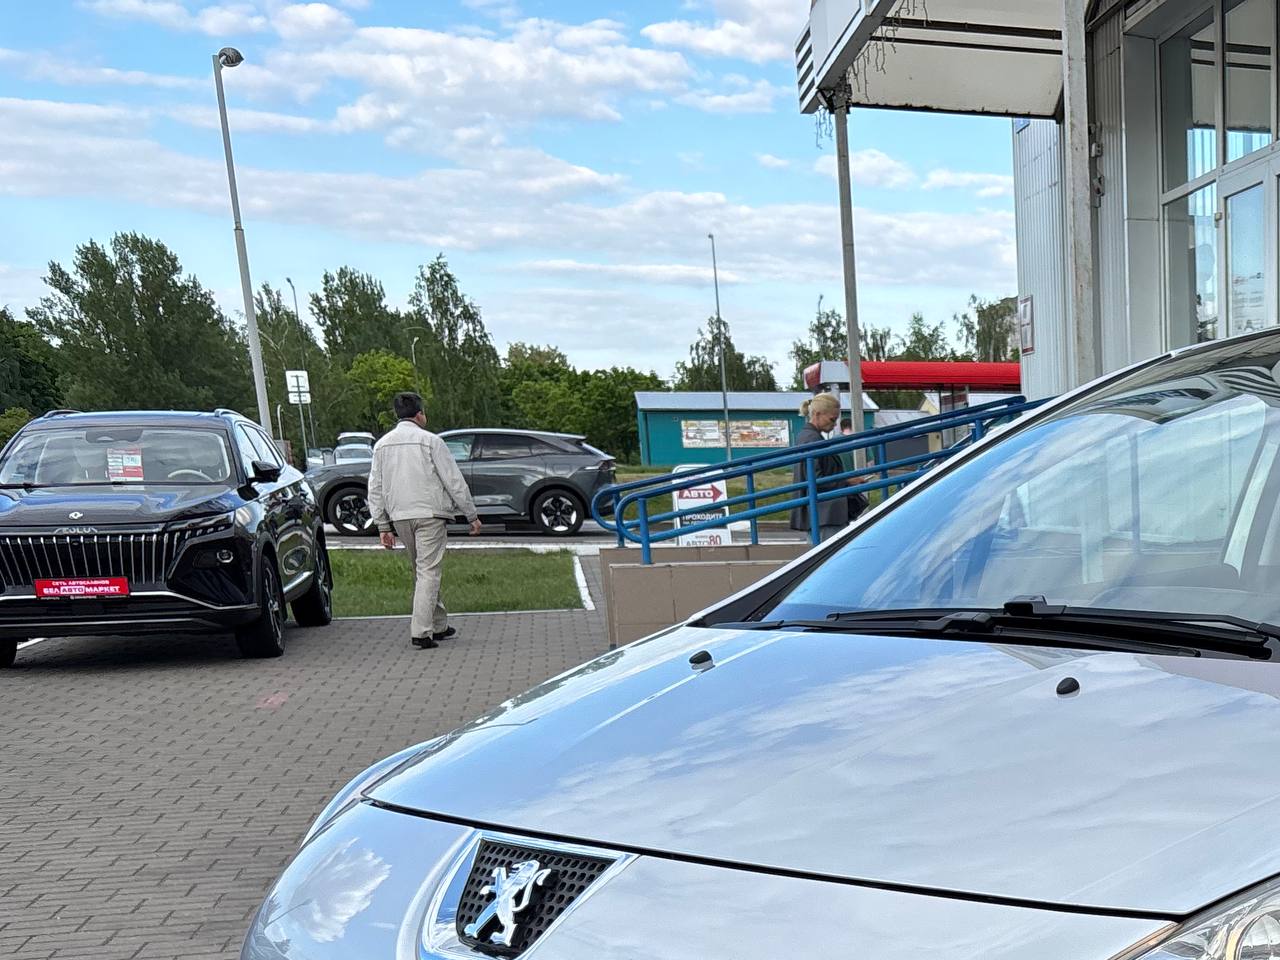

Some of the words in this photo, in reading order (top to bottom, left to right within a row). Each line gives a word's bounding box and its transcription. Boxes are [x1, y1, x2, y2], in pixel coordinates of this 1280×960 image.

[683, 489, 714, 498] АВТО
[61, 586, 84, 594] АВТО
[85, 585, 121, 594] МАРКЕТ
